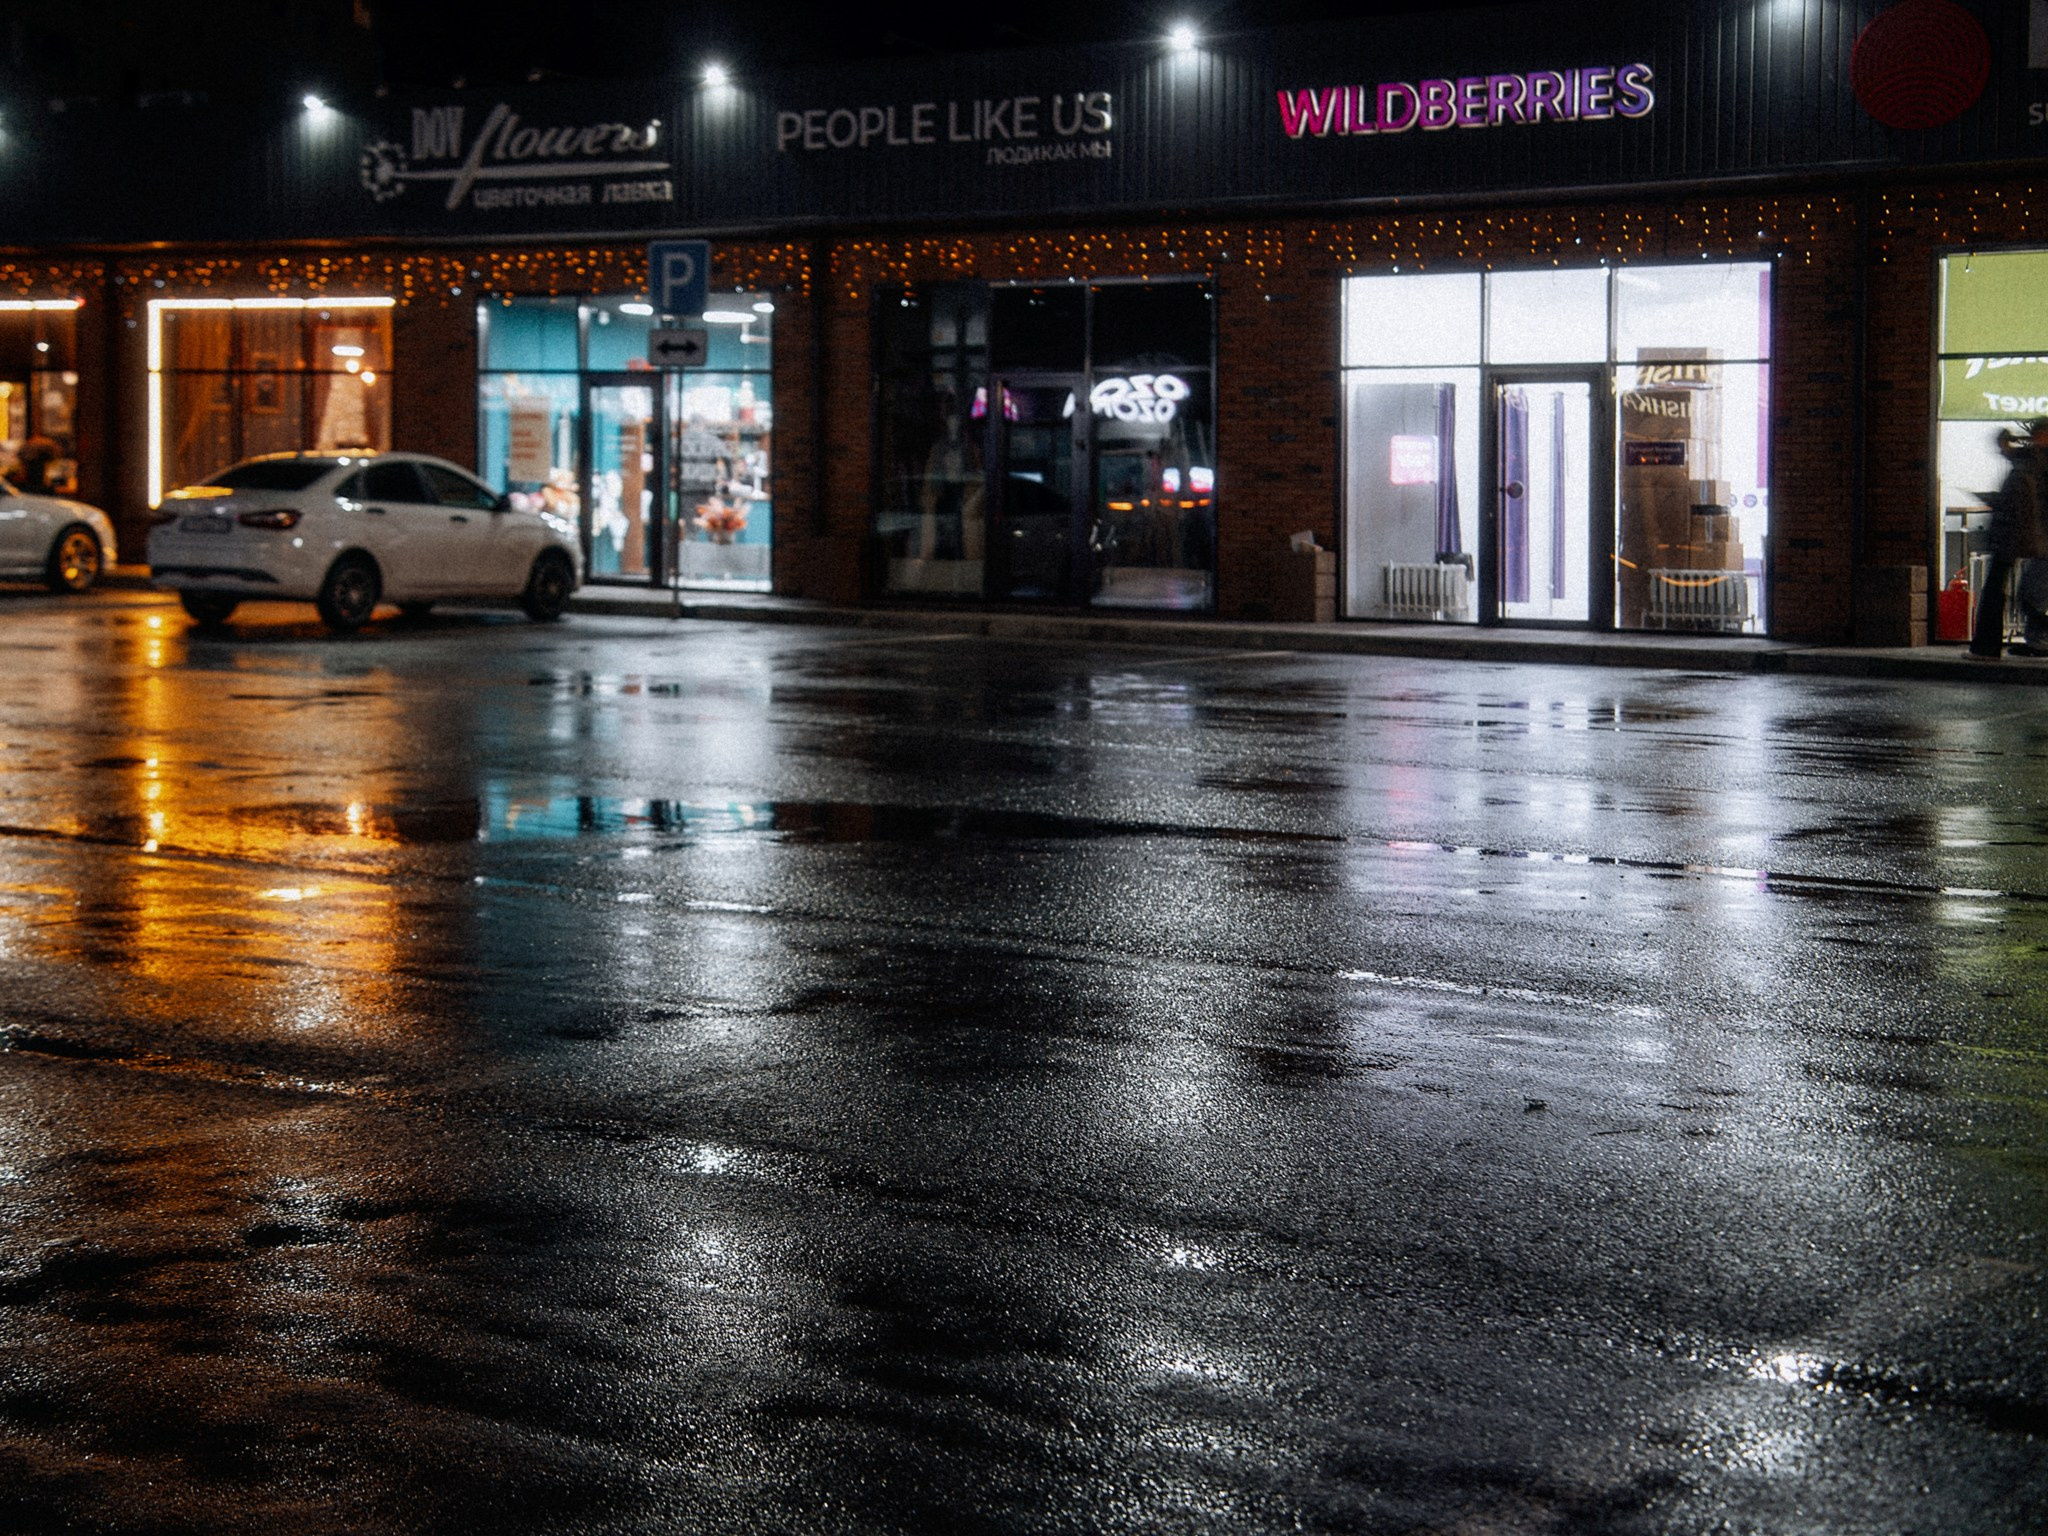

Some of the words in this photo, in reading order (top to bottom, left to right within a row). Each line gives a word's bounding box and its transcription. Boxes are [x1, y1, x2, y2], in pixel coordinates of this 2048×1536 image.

[777, 102, 938, 151] PEOPLE
[949, 96, 1041, 142] LIKE
[1053, 91, 1113, 136] US
[1276, 62, 1654, 138] WILDBERRIES
[662, 252, 695, 308] P
